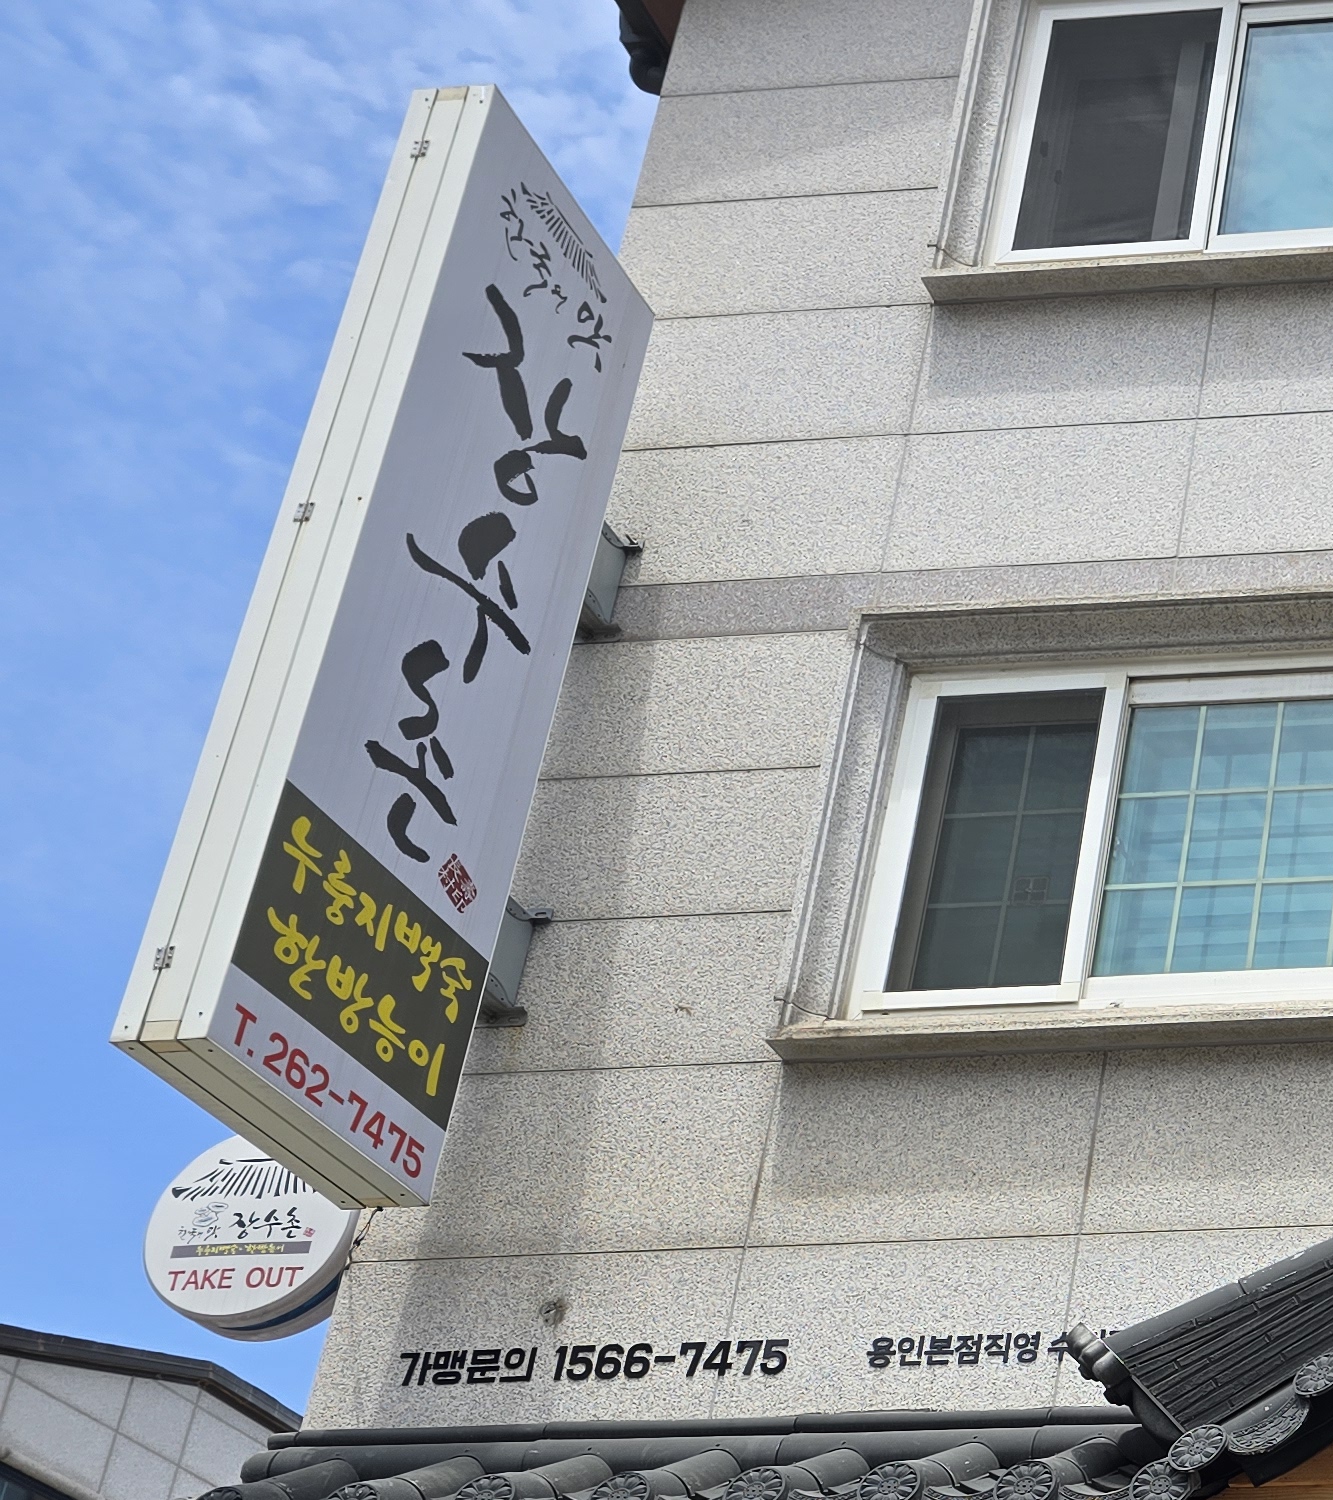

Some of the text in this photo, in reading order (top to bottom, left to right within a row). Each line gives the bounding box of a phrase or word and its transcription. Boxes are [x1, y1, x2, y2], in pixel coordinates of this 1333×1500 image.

[567, 300, 613, 374] 맛
[365, 283, 587, 863] 장수촌
[283, 815, 473, 1024] 누룽지백숙
[268, 906, 446, 1097] 한방능이
[233, 1003, 425, 1179] T. 262-7475
[229, 1207, 302, 1239] 장수촌
[168, 1266, 304, 1291] TAKE OUT
[400, 1340, 789, 1387] 가맹문의 1566-7475
[866, 1331, 1042, 1368] 용인본점직영
